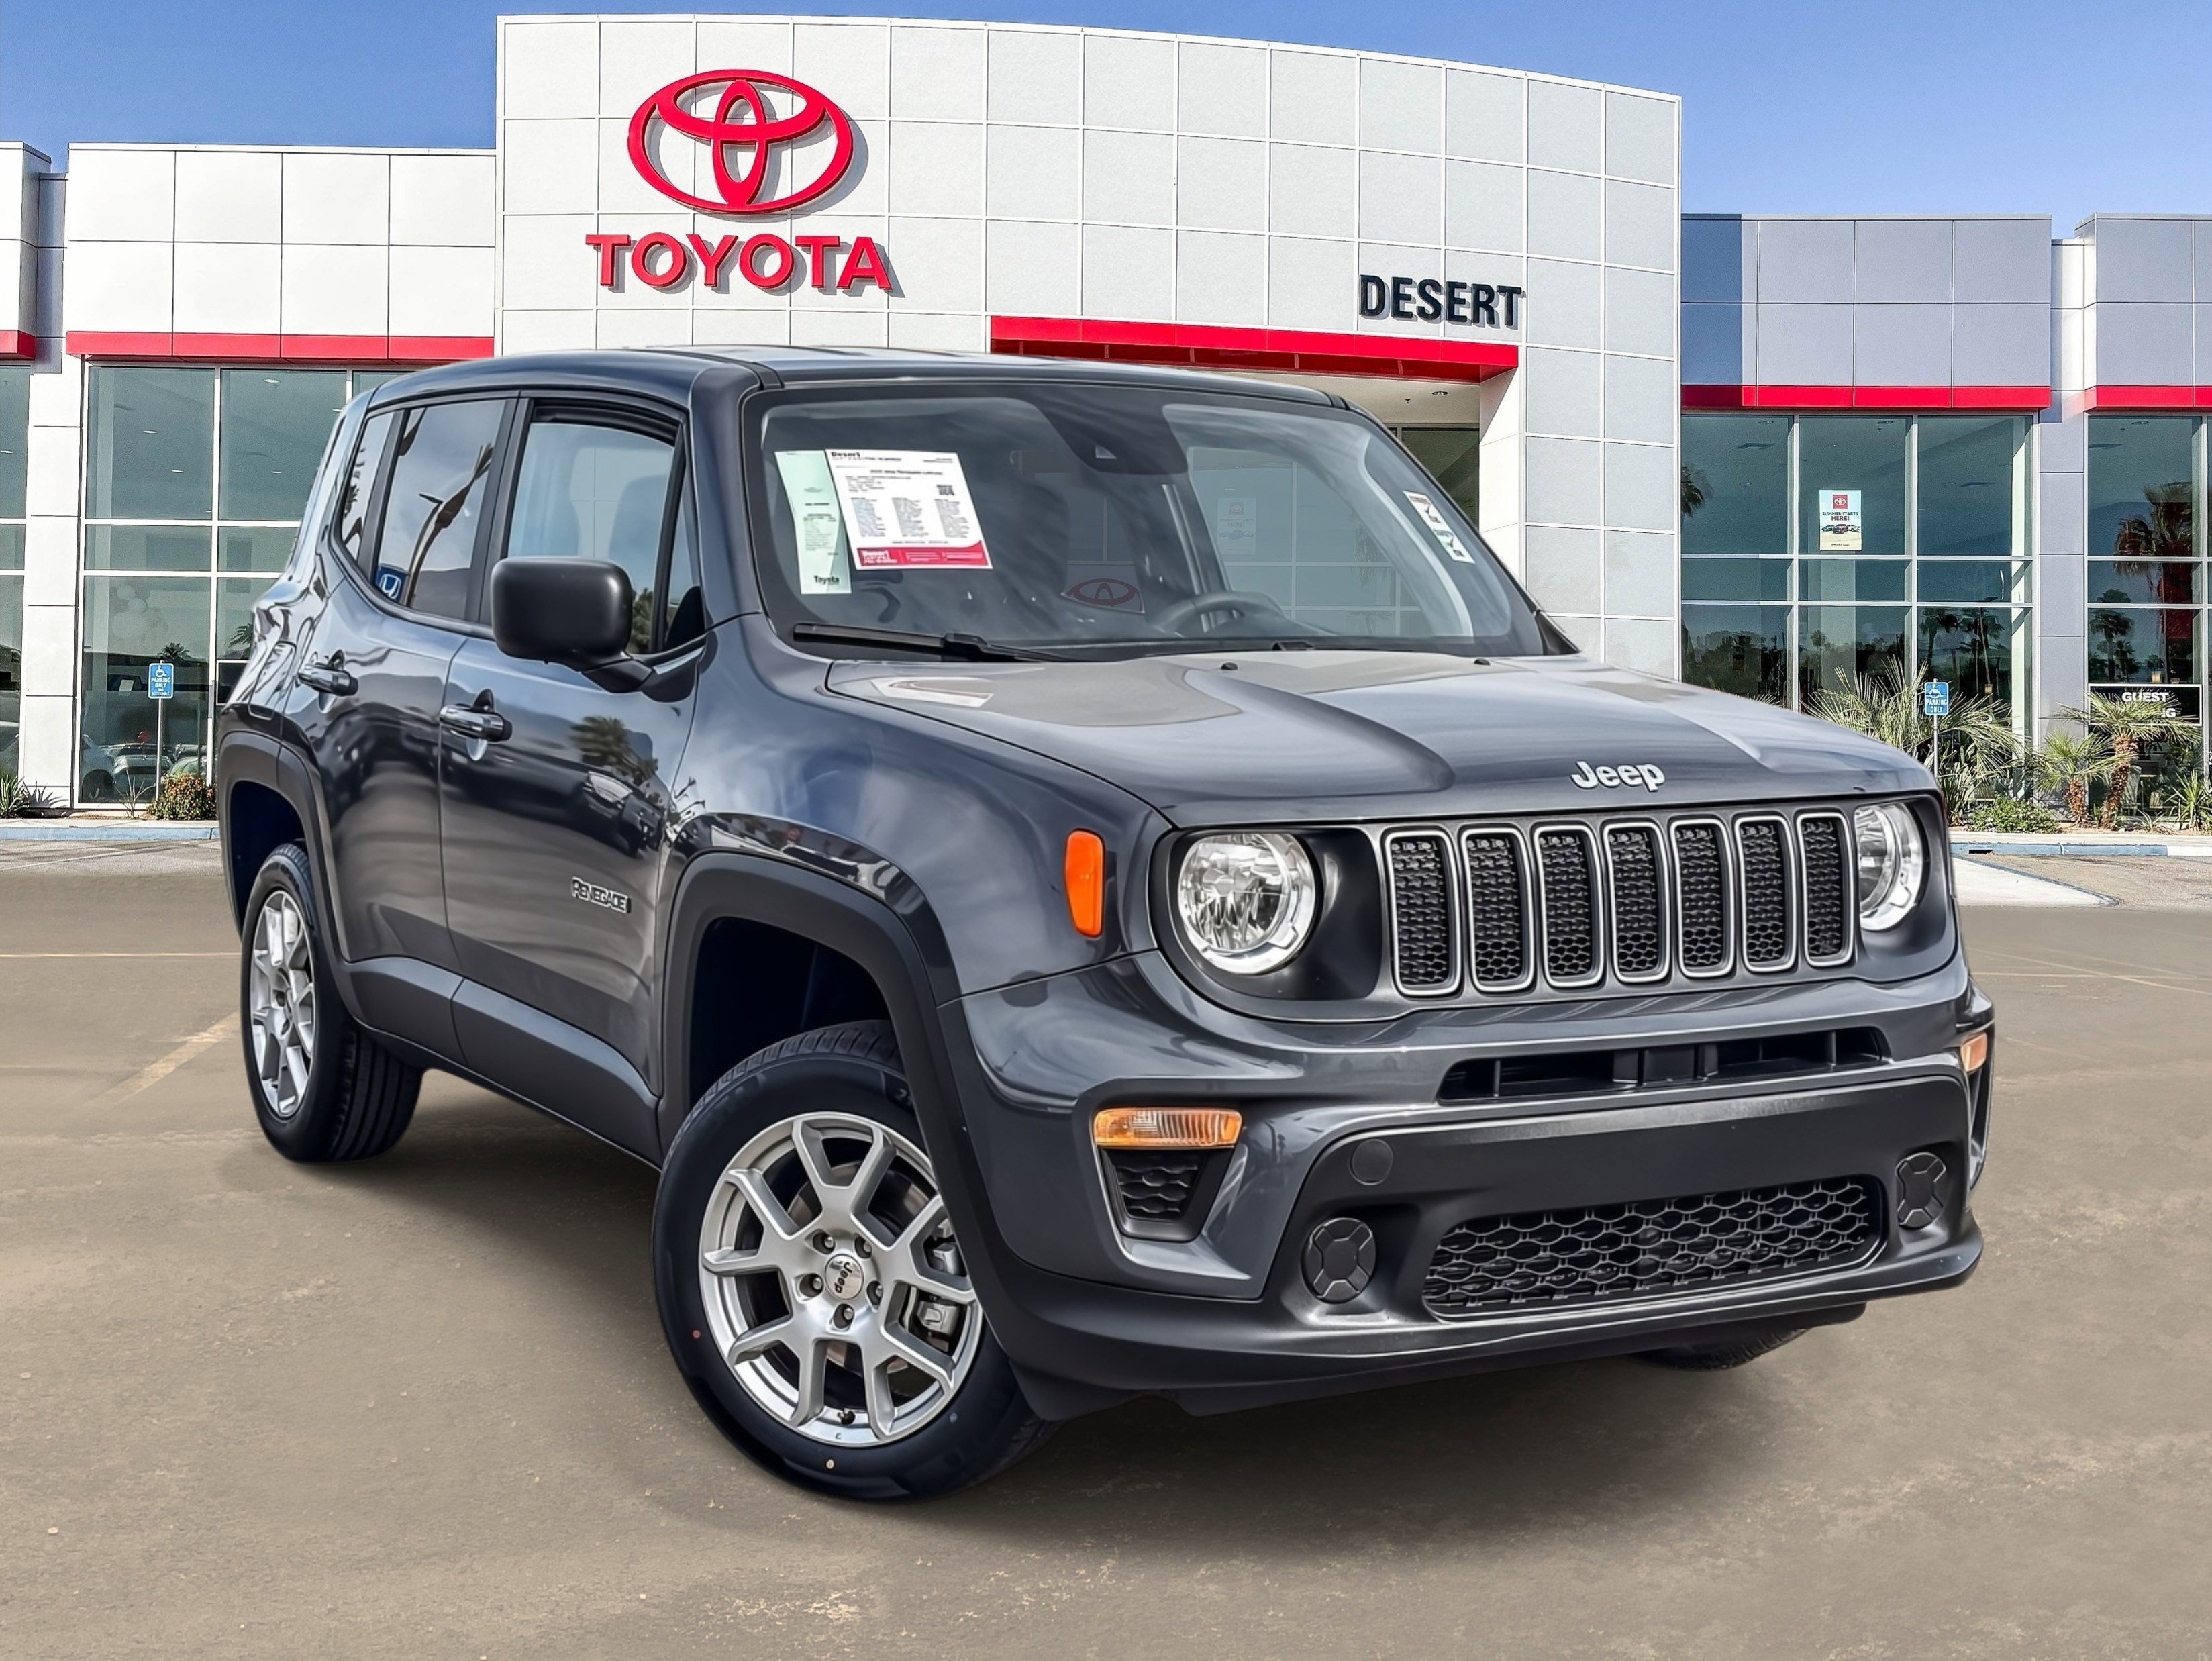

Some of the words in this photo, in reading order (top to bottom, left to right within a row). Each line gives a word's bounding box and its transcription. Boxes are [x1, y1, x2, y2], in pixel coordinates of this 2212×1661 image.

[585, 232, 893, 291] TOYOTA
[1359, 274, 1522, 327] DESERT
[813, 575, 840, 585] Toyota
[2121, 691, 2169, 703] GUEST
[1570, 760, 1666, 793] Jeep
[571, 876, 629, 913] RENEGADE
[834, 1262, 853, 1294] Jeep
